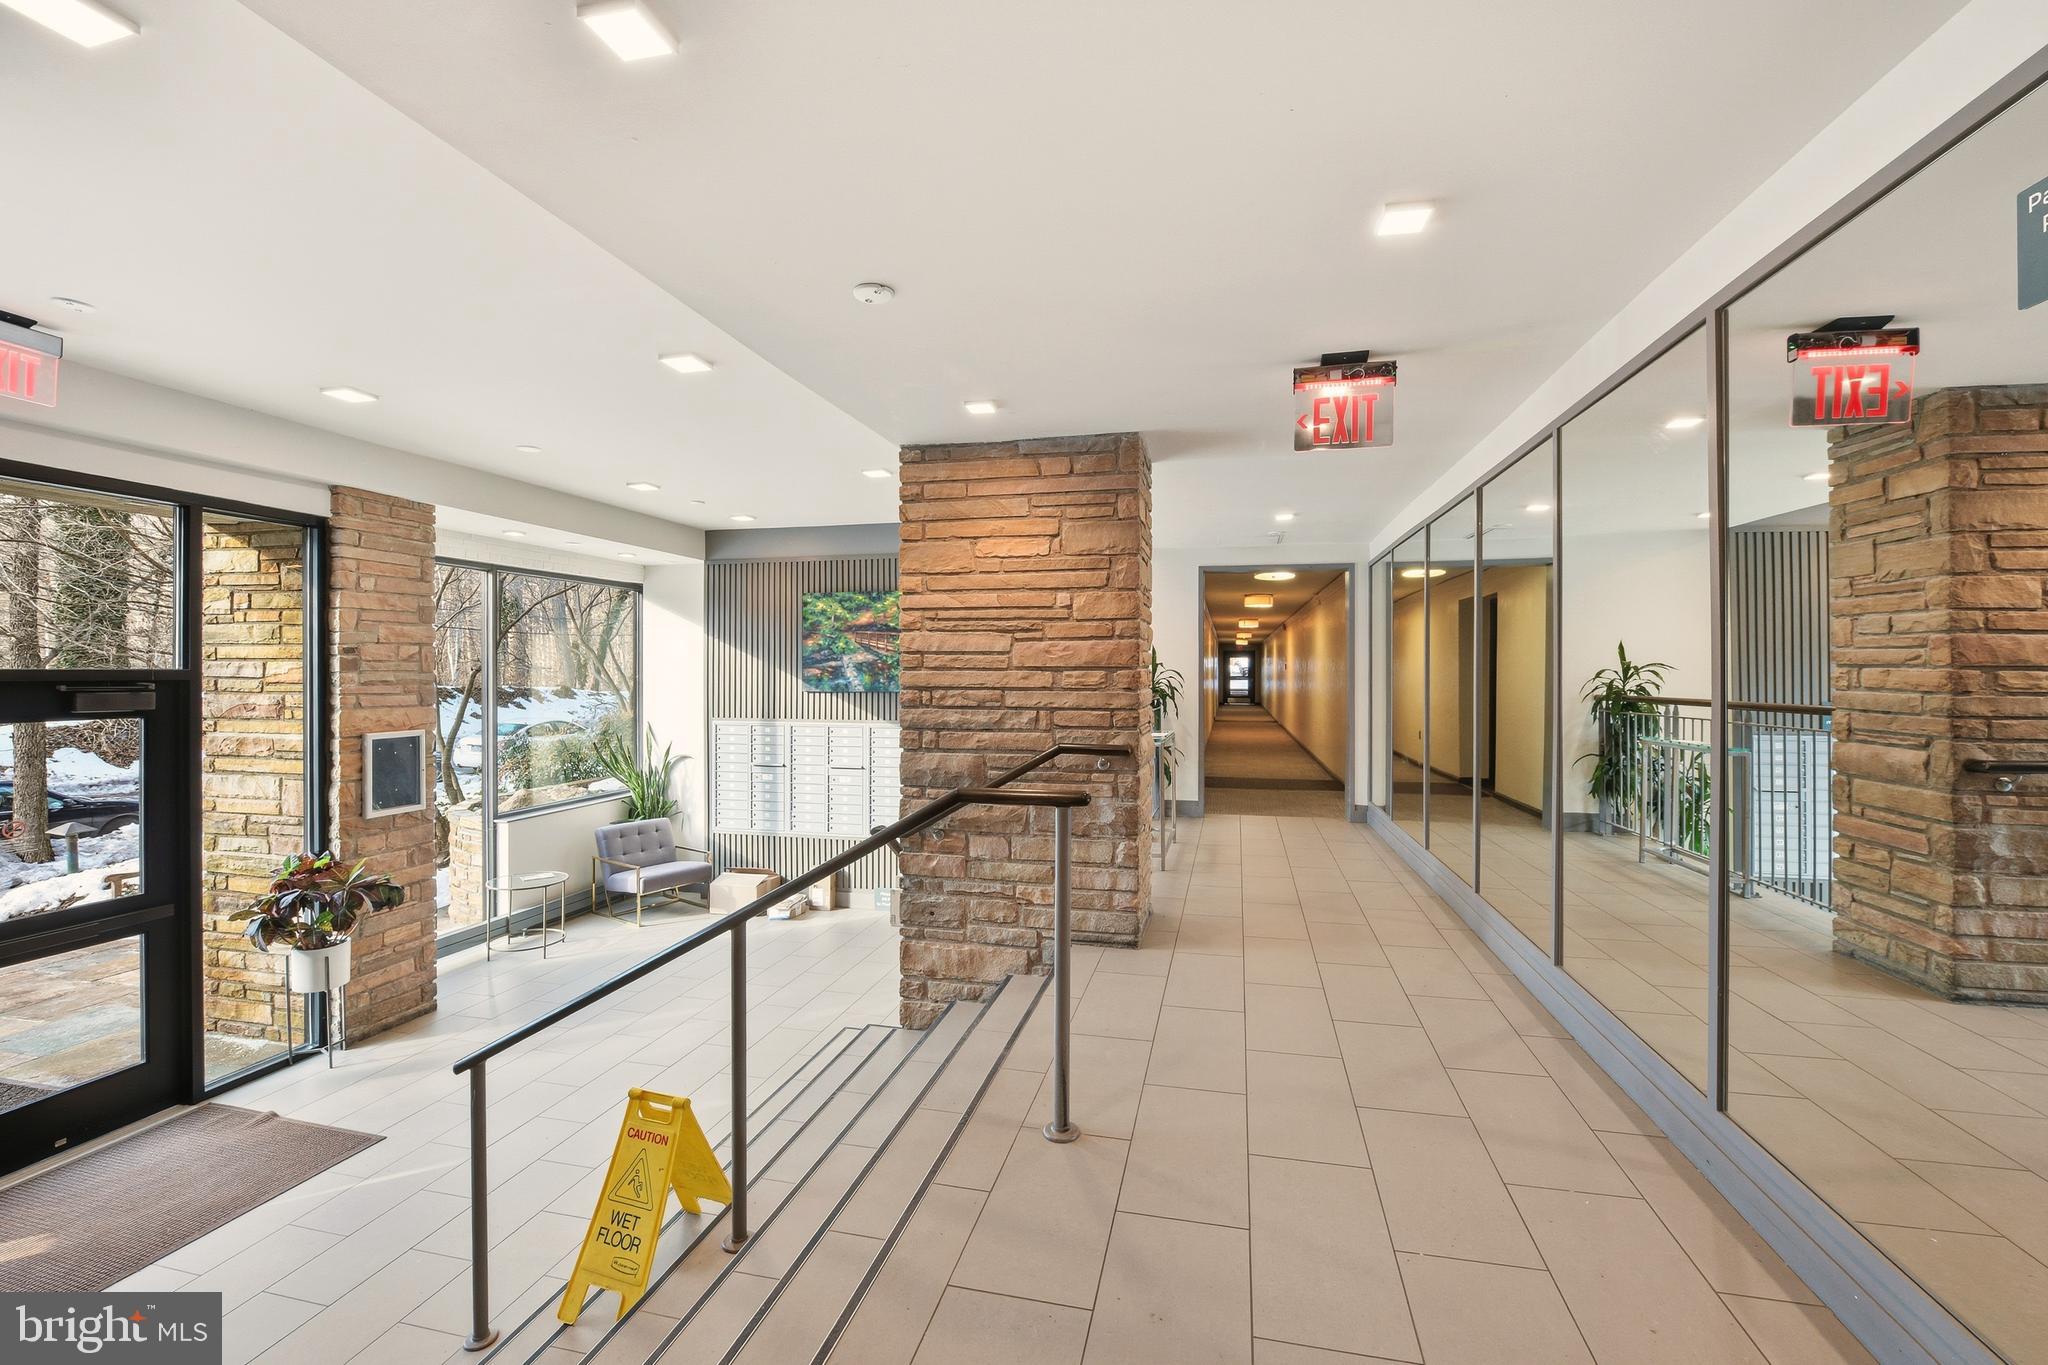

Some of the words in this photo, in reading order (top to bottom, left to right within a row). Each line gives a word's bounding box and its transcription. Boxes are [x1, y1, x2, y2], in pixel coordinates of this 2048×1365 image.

[1313, 394, 1379, 445] EXIT
[627, 1127, 668, 1146] CAUTION
[610, 1209, 641, 1231] WET
[596, 1226, 642, 1254] FLOOR
